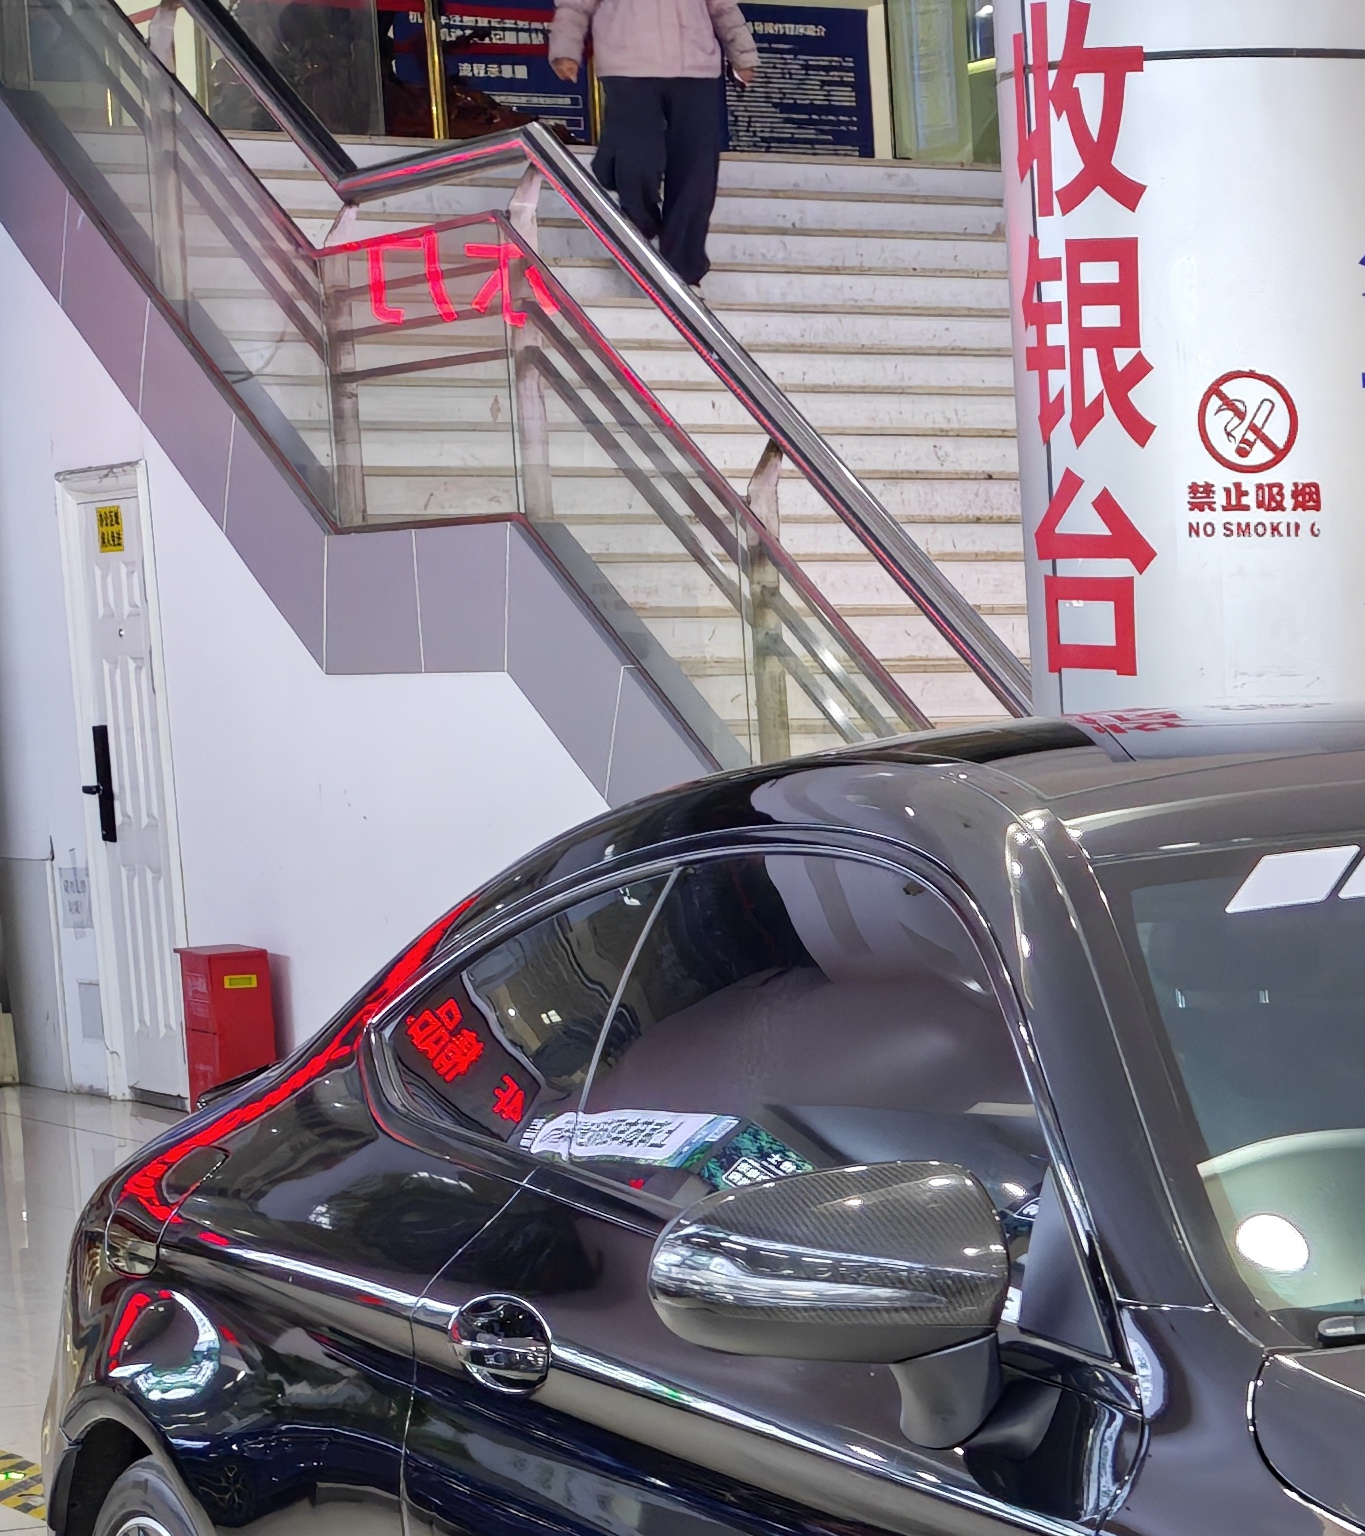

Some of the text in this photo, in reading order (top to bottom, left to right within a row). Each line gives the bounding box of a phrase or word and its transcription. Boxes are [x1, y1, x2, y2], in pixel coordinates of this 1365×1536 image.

[1013, 0, 1158, 677] 收银台
[1186, 480, 1323, 513] 禁止吸烟
[1187, 521, 1216, 539] NO
